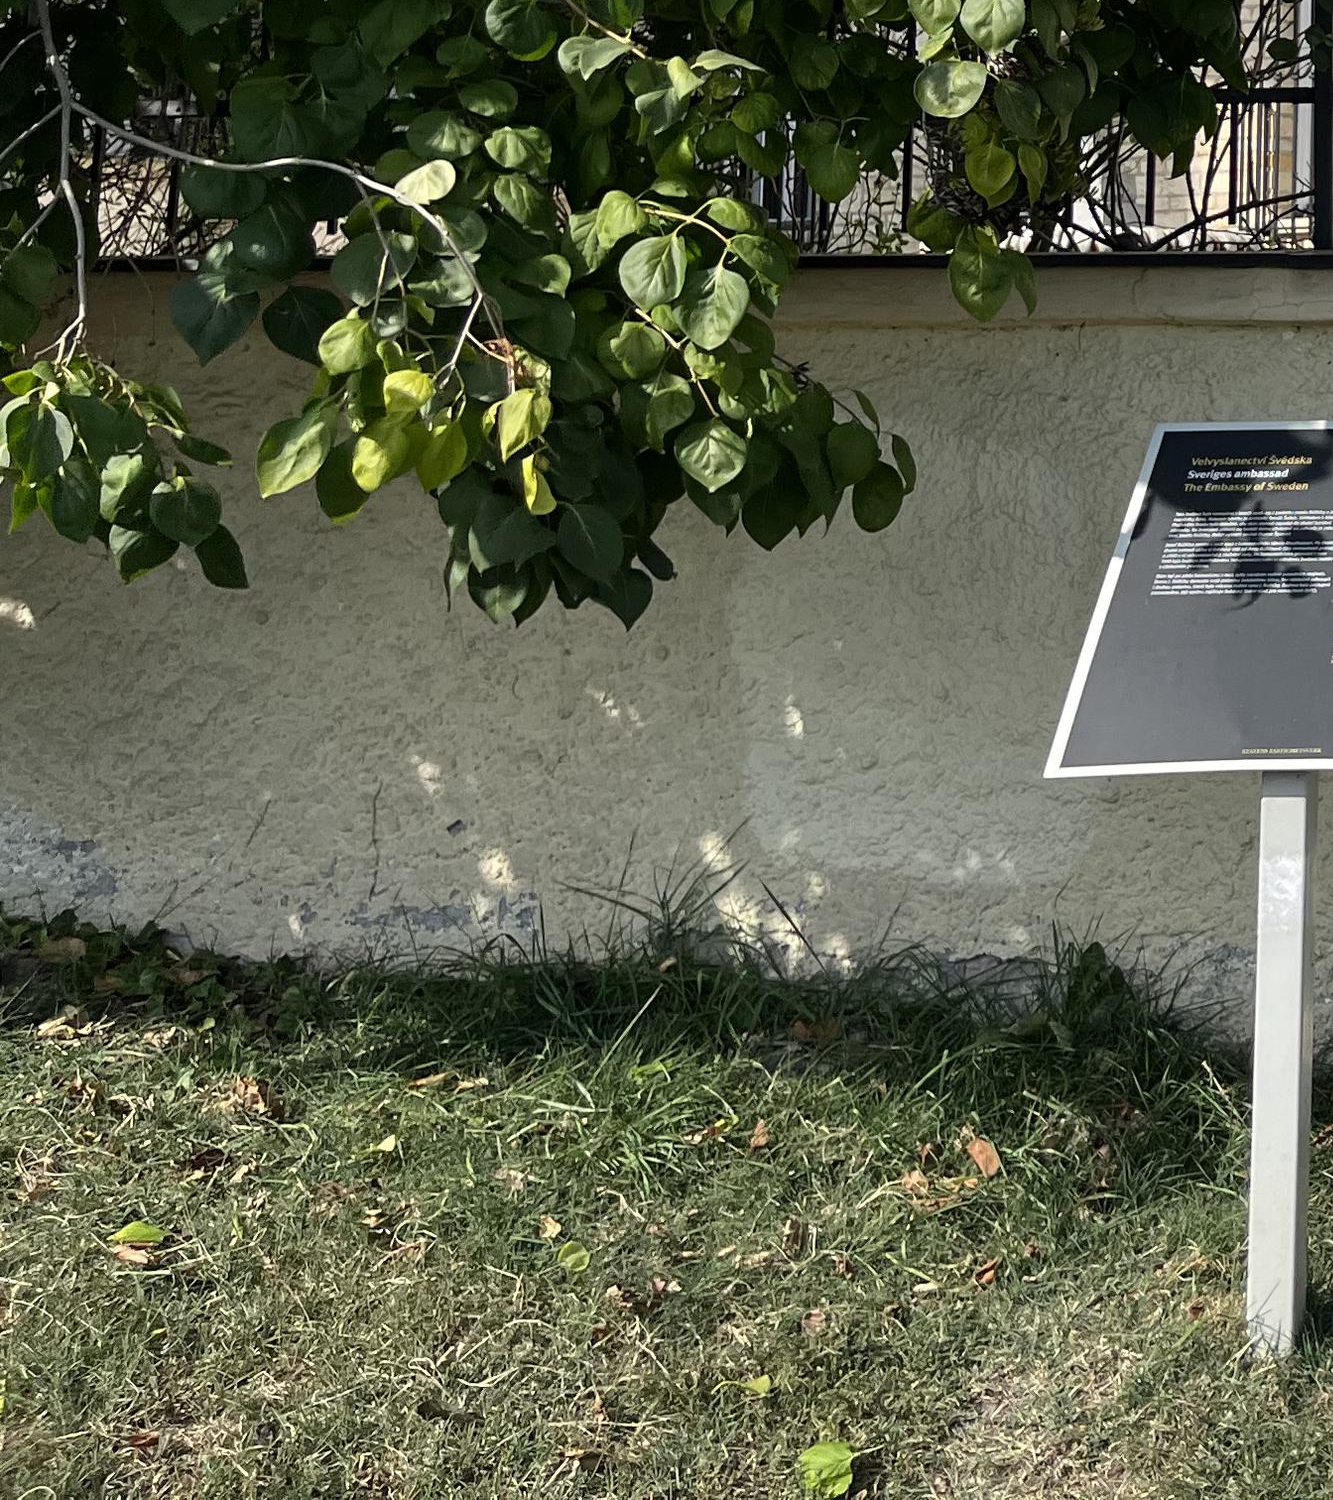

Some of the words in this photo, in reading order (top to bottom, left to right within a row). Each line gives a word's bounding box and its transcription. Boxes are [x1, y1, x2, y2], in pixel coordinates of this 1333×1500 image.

[1268, 455, 1313, 465] Švédska
[1186, 469, 1232, 480] Sveriges
[1233, 468, 1289, 478] ambassad
[1183, 483, 1203, 492] The
[1204, 482, 1252, 493] Embassy
[1252, 481, 1264, 491] of
[1266, 481, 1309, 491] Sweden
